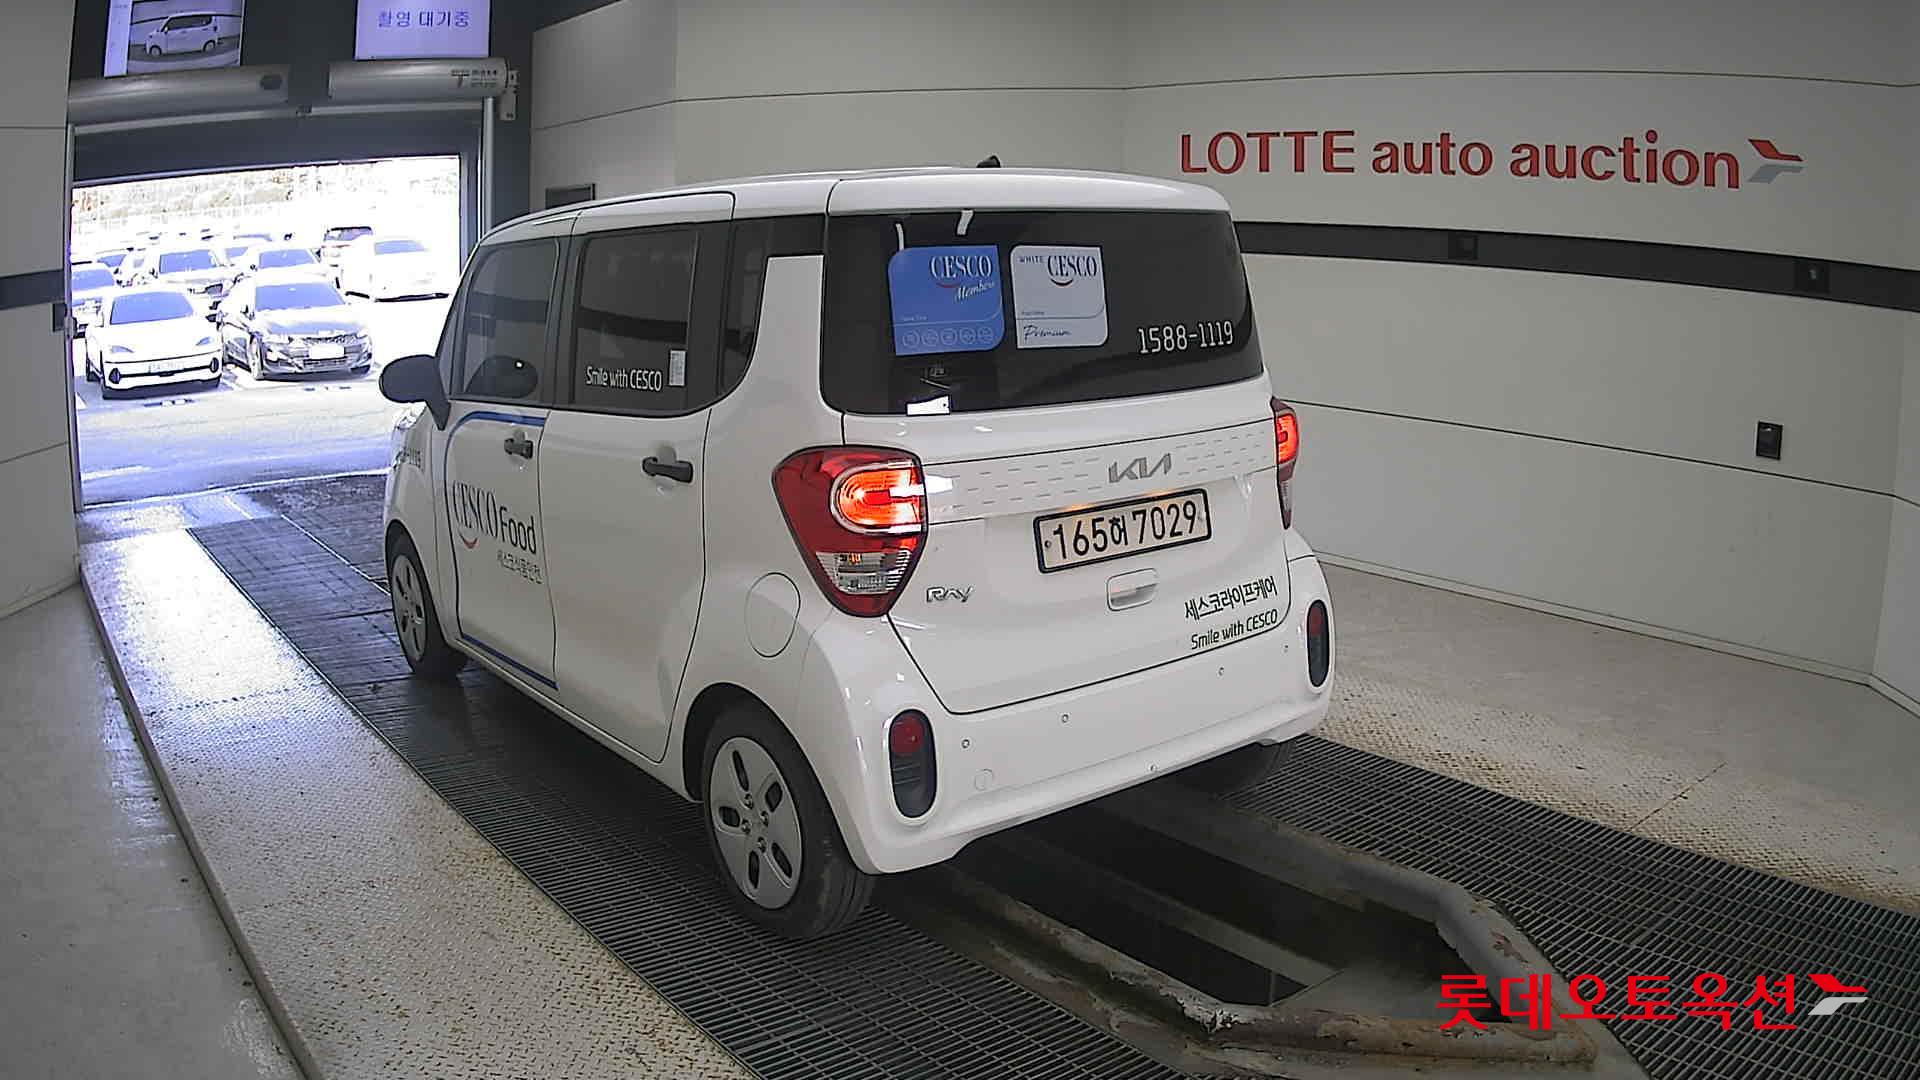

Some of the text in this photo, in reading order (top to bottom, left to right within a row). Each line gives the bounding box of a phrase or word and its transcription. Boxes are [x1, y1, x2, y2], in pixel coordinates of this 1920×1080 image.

[418, 10, 469, 28] 대기중
[1180, 129, 1740, 190] LOTTE auto auction
[930, 255, 993, 279] CESCO
[1047, 254, 1098, 278] CESCO
[1138, 320, 1233, 354] 1588-1119
[586, 365, 662, 392] Smile with CESCO
[1108, 452, 1172, 484] KIA
[452, 479, 537, 555] CESCO Food
[1052, 499, 1197, 560] 165허 7029
[1184, 575, 1278, 621] 세스코라이프케어
[1191, 608, 1278, 650] Smile with CESCO
